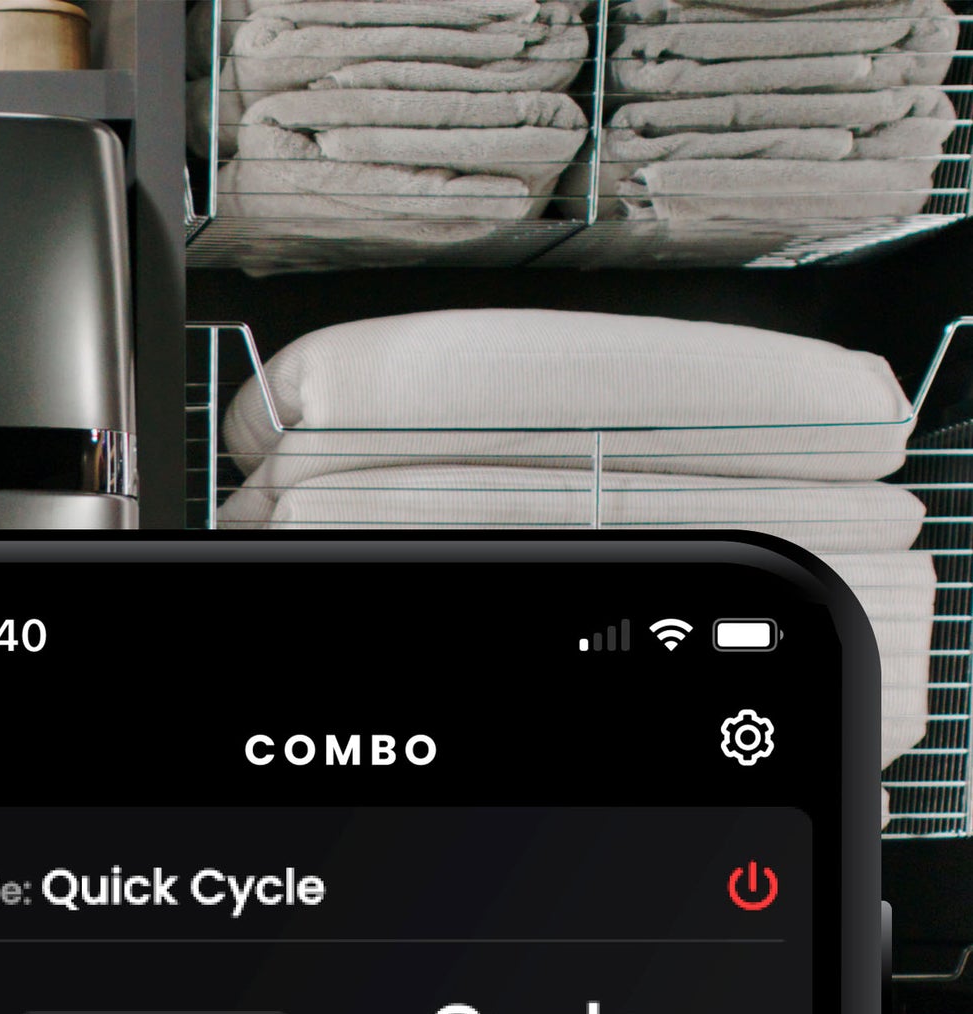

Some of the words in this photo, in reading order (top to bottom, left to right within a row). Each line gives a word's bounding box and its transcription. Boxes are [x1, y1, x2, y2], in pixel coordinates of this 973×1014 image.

[244, 733, 438, 767] COMBO
[41, 864, 180, 912] Quick
[190, 866, 327, 920] Cycle
